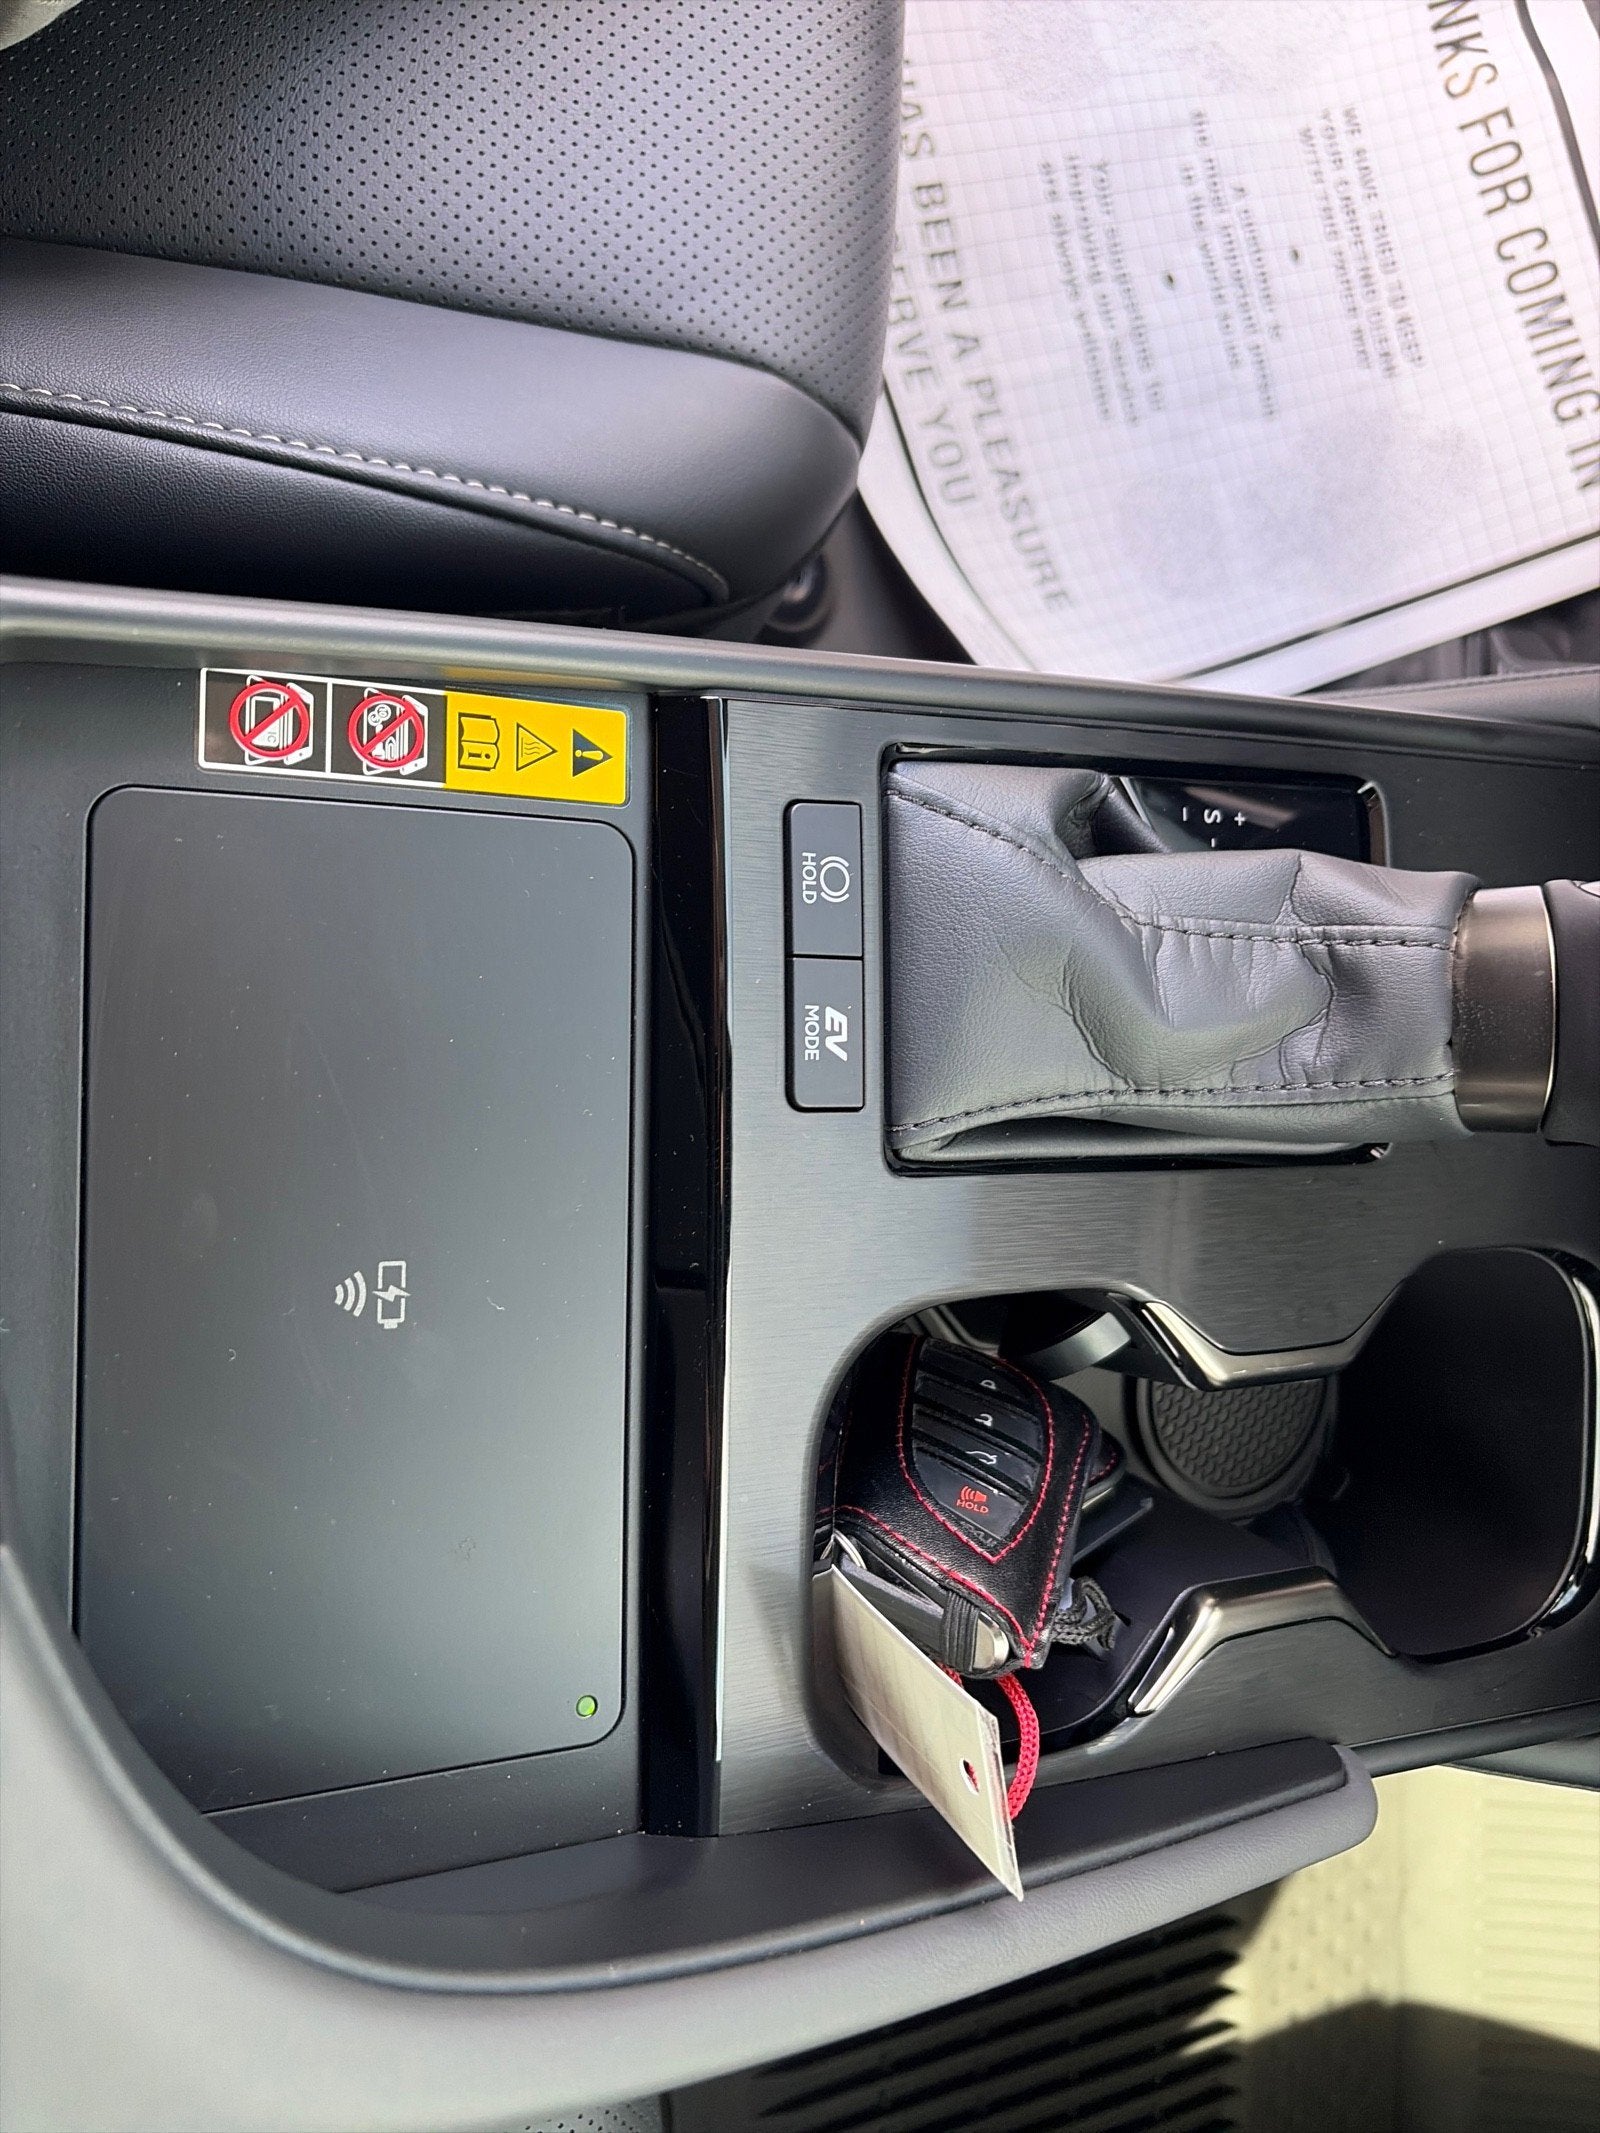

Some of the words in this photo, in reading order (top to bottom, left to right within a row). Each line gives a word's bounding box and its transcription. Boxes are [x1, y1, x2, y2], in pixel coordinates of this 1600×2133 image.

[1343, 106, 1361, 137] WE
[1091, 160, 1113, 216] Your
[1353, 147, 1378, 201] HAVE
[1457, 105, 1534, 217] FOR
[914, 181, 969, 310] BEEN
[1191, 110, 1210, 147] the
[1219, 224, 1258, 335] important
[1299, 125, 1325, 185] WITH
[1318, 189, 1340, 241] THIS
[1331, 244, 1361, 319] PAPER
[1352, 325, 1372, 371] MAT
[1320, 106, 1344, 172] YOUR
[1333, 176, 1380, 302] CARPETING
[1365, 305, 1399, 380] CLEAN
[1369, 209, 1400, 275] TRIED
[1051, 212, 1082, 301] always
[1386, 278, 1408, 310] TO
[950, 331, 981, 360] A
[1395, 313, 1426, 369] KEEP
[1495, 226, 1600, 424] COMING
[888, 250, 940, 393] RVE
[920, 407, 977, 507] YOU
[964, 376, 1074, 611] PLEASURE
[1203, 808, 1222, 824] S
[801, 851, 818, 905] HOLD
[803, 1004, 820, 1061] MODE
[824, 1005, 848, 1062] EV
[956, 1498, 989, 1514] HOLD
